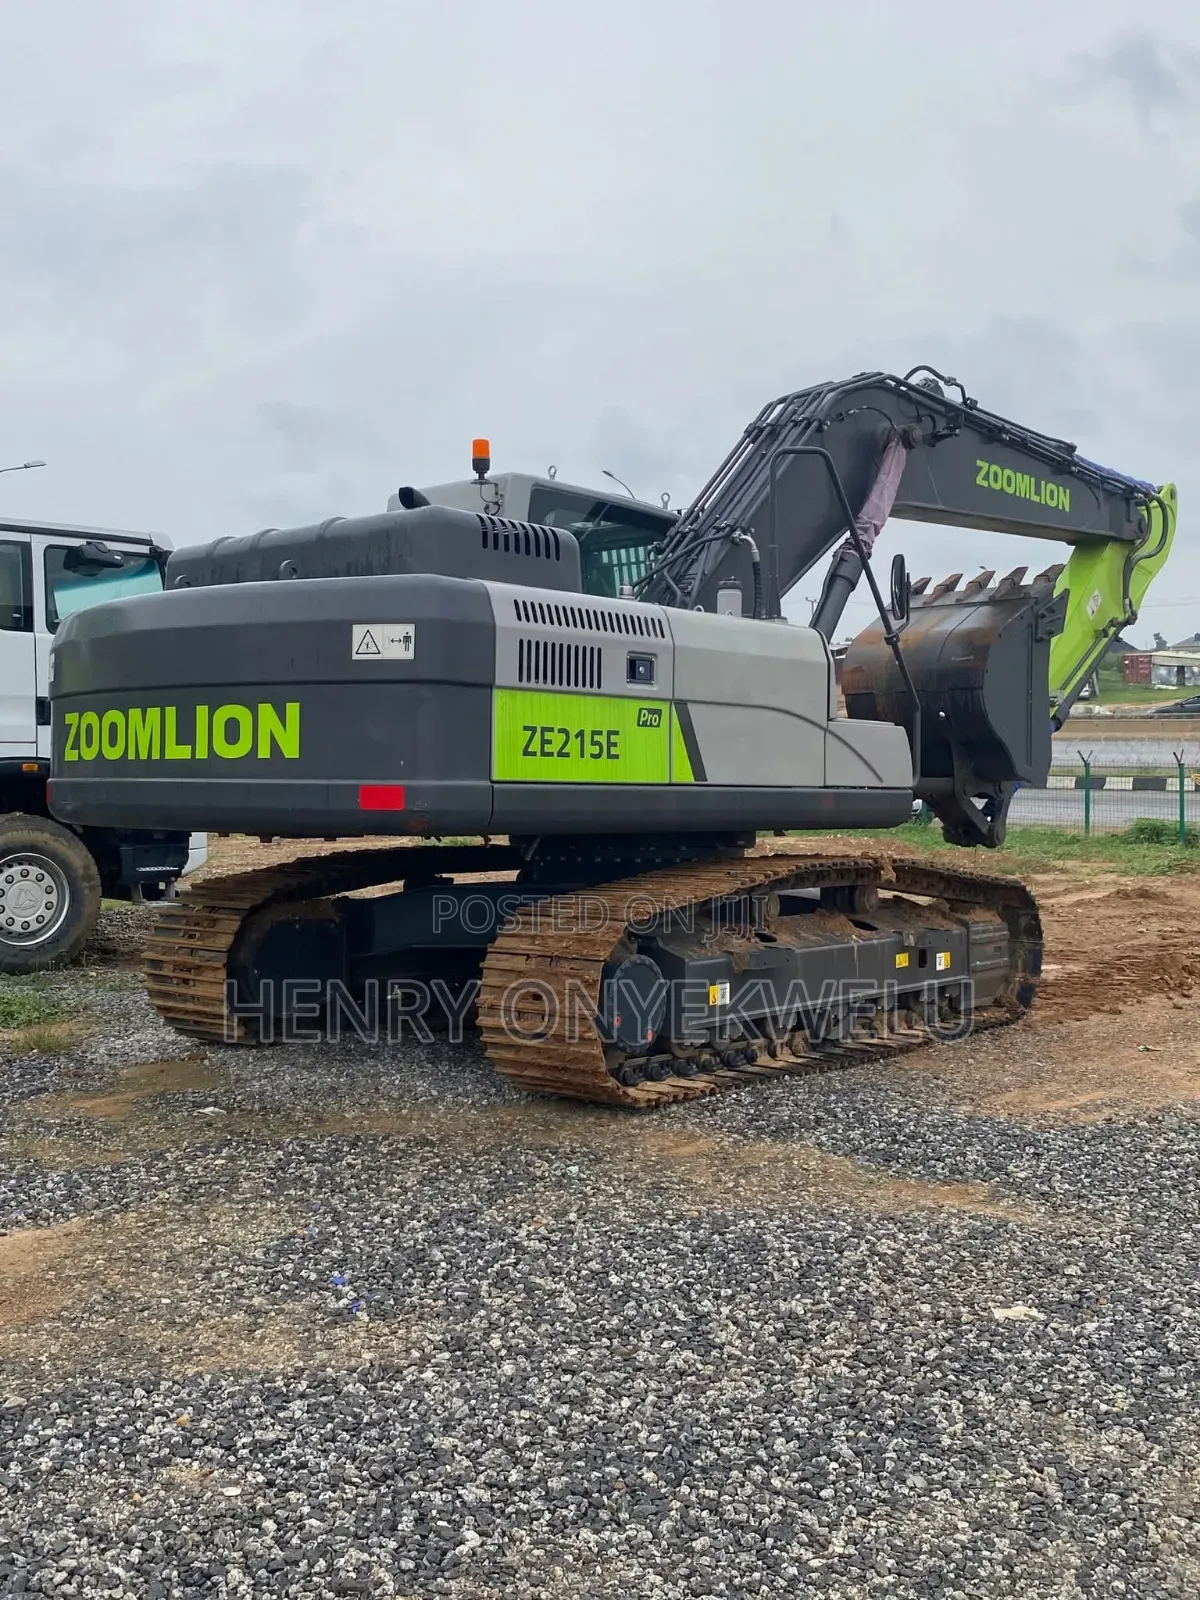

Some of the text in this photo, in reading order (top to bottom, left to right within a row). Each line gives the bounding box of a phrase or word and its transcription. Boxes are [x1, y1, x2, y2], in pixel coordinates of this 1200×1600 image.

[976, 459, 1070, 512] ZOOMLION
[64, 702, 300, 761] ZOOMLION
[640, 709, 659, 726] Pro
[522, 725, 620, 760] ZE215E
